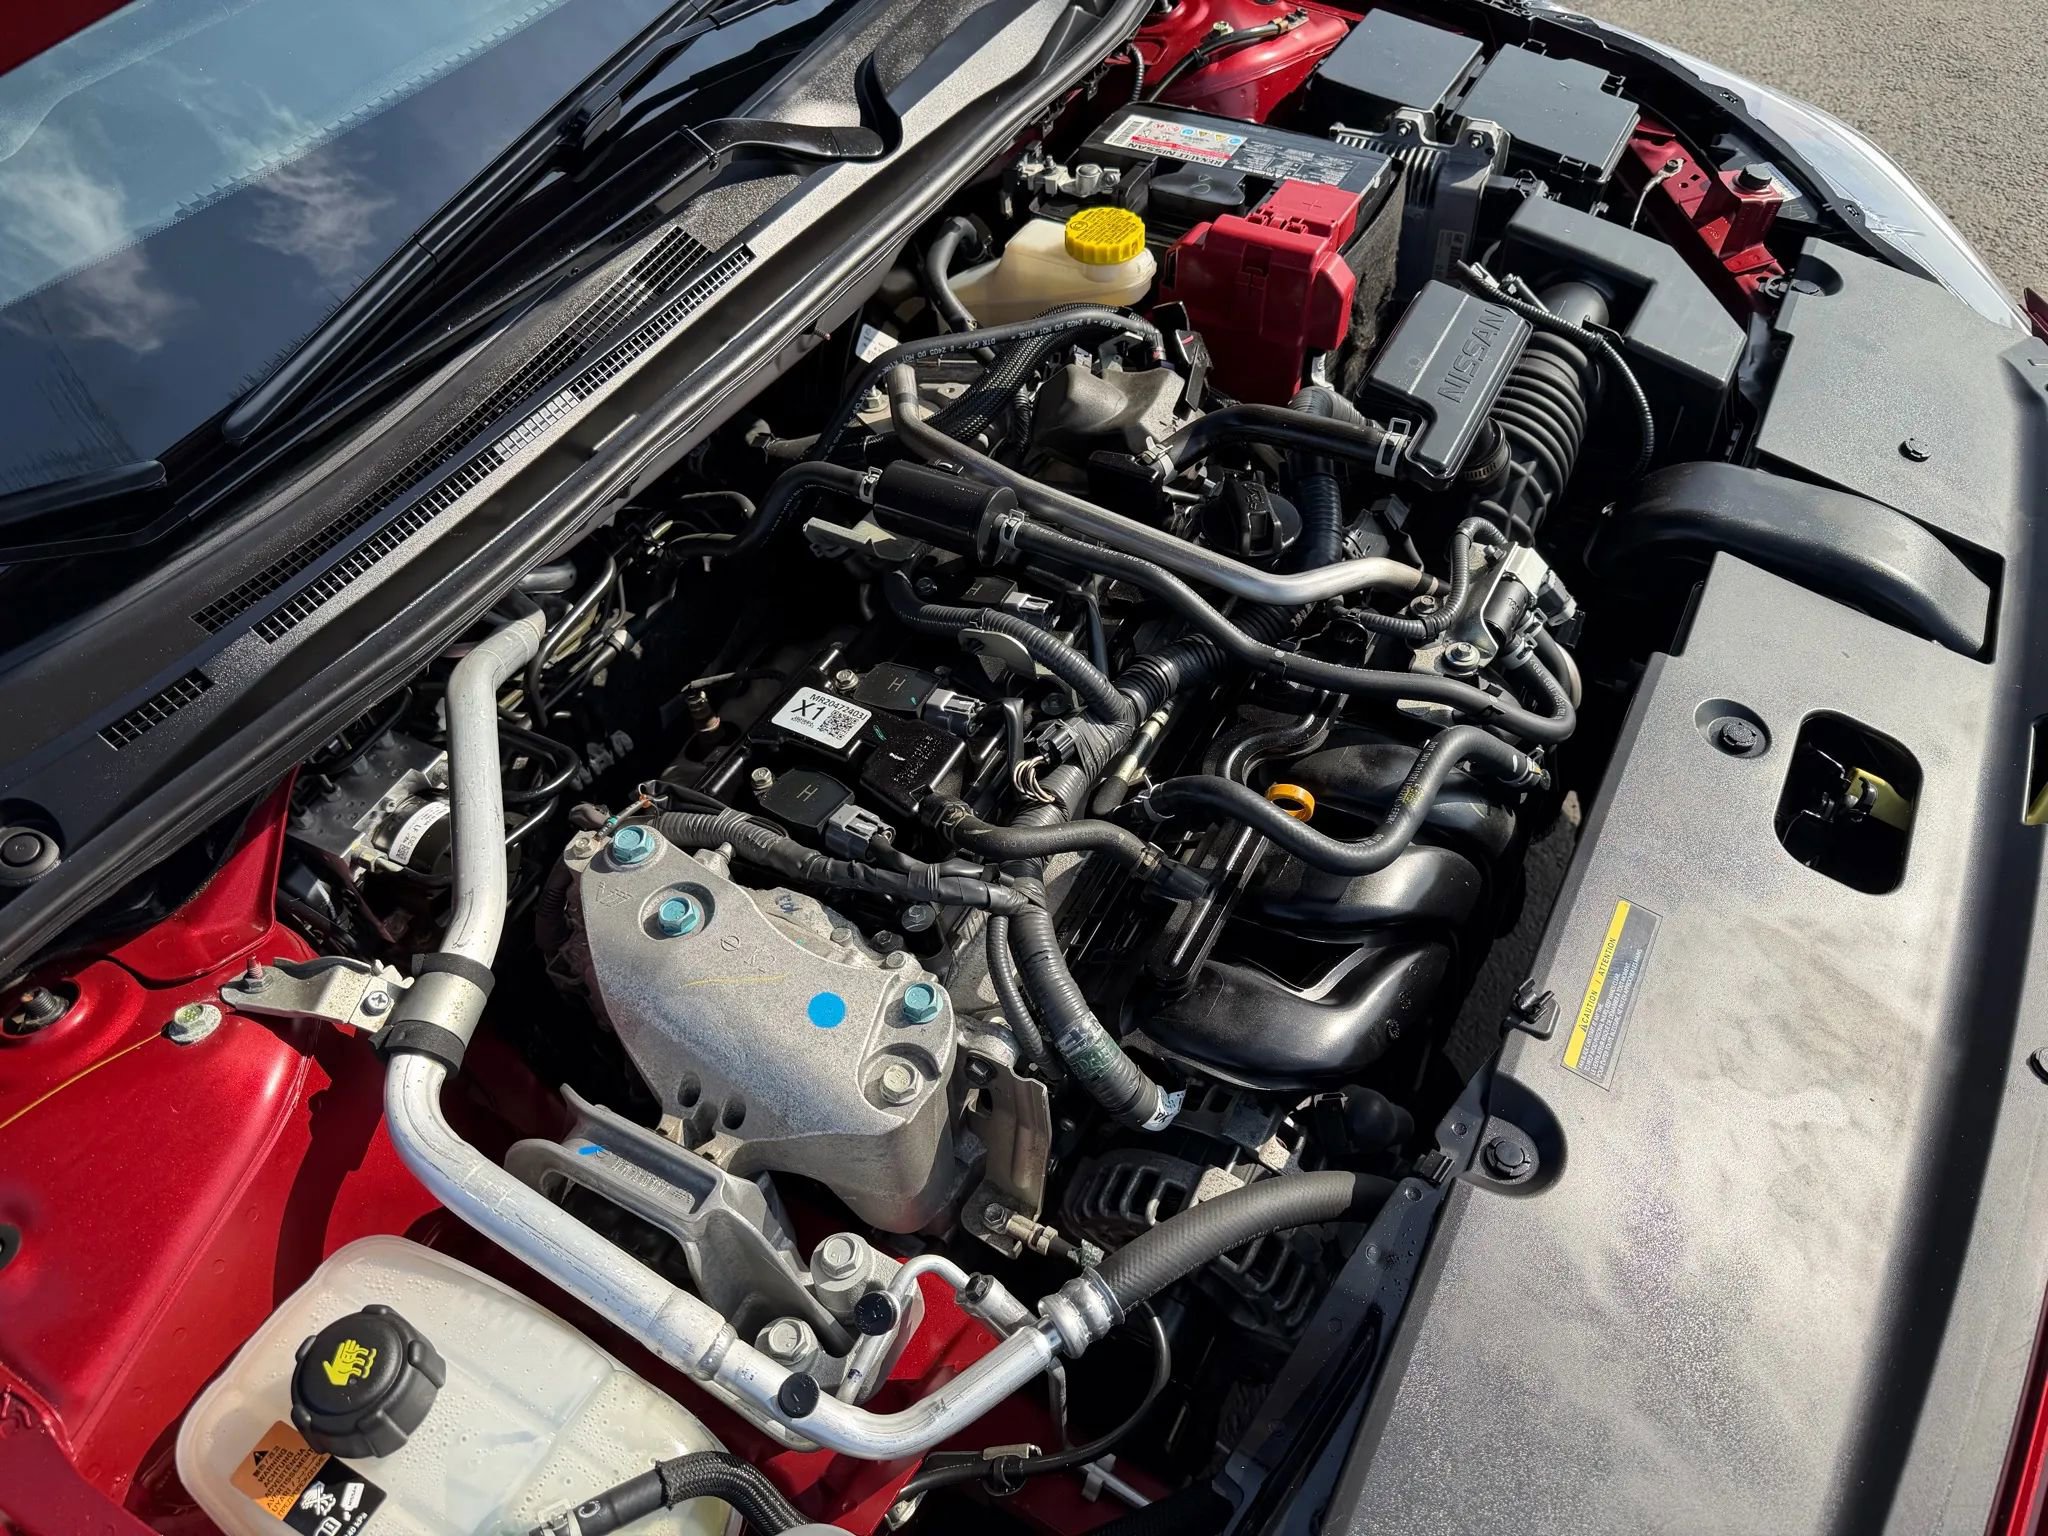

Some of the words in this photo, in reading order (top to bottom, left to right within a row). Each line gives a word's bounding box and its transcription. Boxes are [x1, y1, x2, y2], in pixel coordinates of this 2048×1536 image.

[1127, 142, 1176, 155] NISSAN
[1437, 308, 1505, 404] NISSAN
[790, 698, 826, 720] X1
[1584, 990, 1598, 1024] CAUTION
[1598, 937, 1616, 975] ATTENTION
[257, 1447, 287, 1483] WARNING
[262, 1450, 294, 1488] ACHTUNG
[264, 1446, 315, 1508] AVERTISSEMENT
[270, 1487, 292, 1512] UYARI
